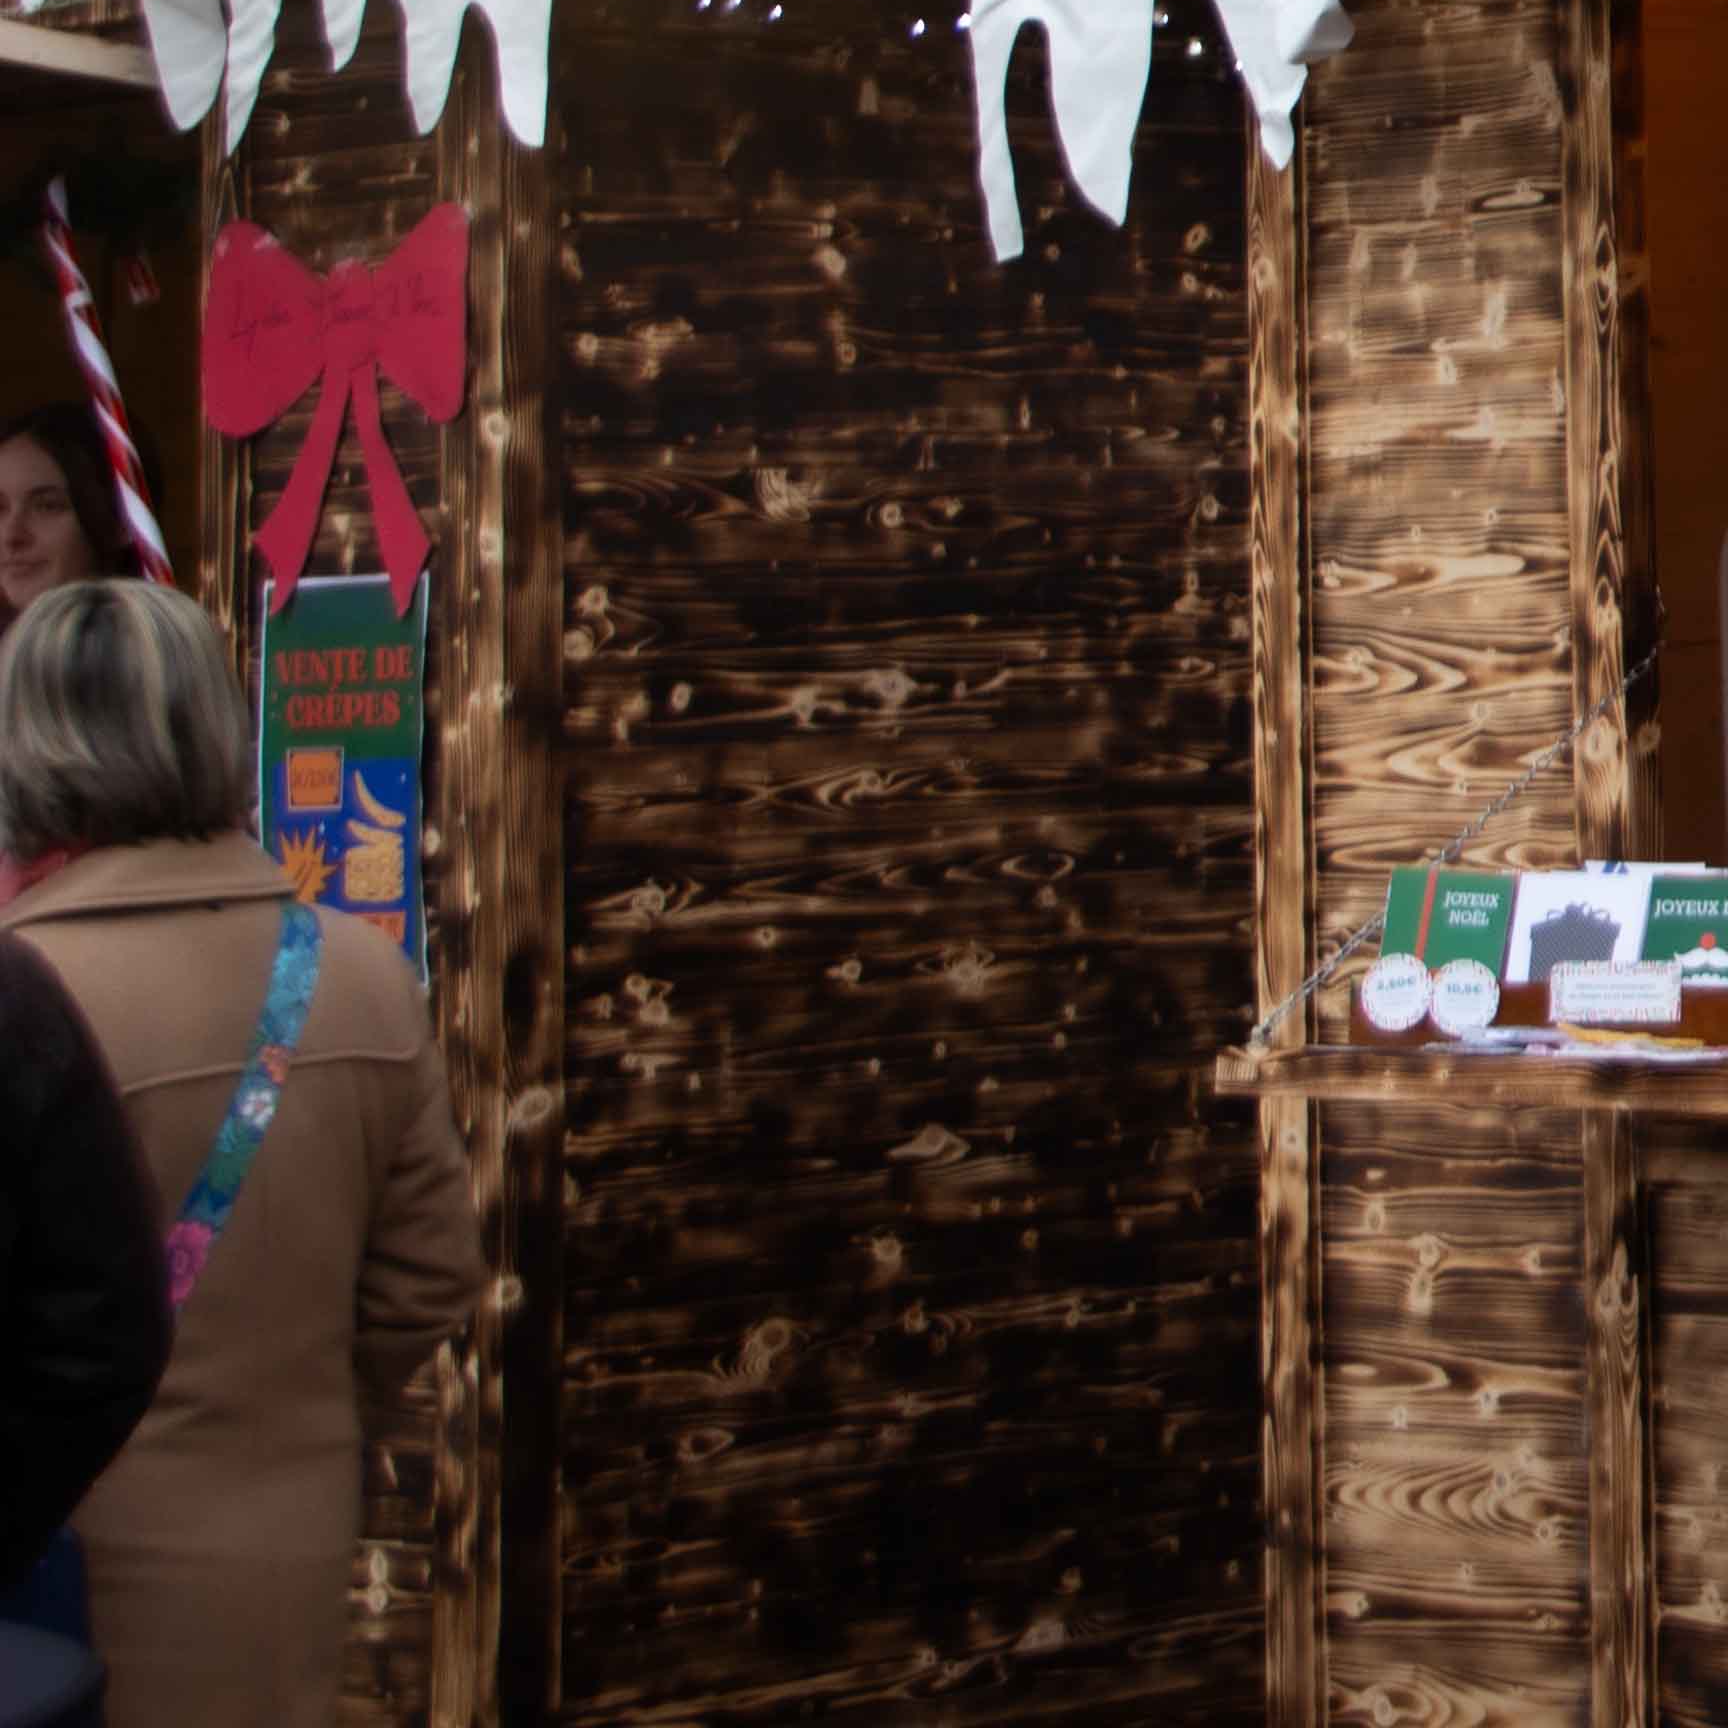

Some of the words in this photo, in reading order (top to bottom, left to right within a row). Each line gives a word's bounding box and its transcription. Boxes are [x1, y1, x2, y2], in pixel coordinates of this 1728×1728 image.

[274, 647, 368, 689] VENTE
[374, 642, 414, 682] DE
[1442, 890, 1501, 909] JOYEUX
[1653, 898, 1719, 917] JOYEUX
[1448, 908, 1491, 927] NOËL
